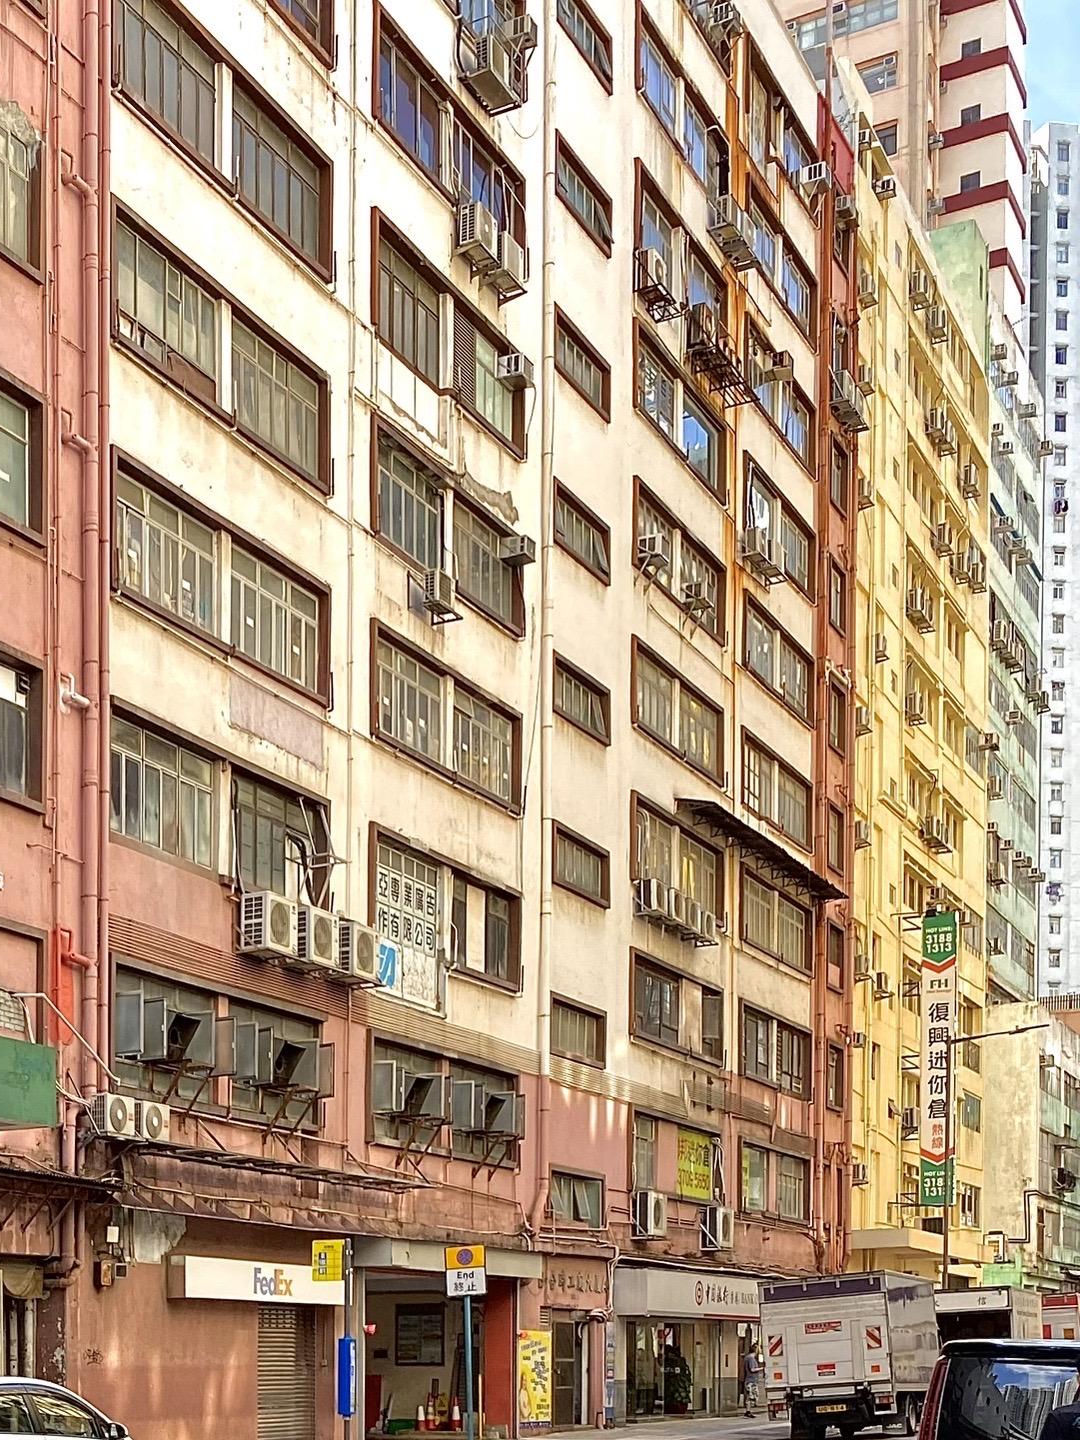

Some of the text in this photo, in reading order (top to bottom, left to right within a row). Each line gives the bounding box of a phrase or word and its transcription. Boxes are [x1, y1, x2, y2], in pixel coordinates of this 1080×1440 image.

[925, 932, 952, 944] 3188
[926, 942, 952, 953] 1313
[928, 1002, 949, 1119] 復興迷你倉
[456, 1270, 475, 1280] End
[253, 1266, 293, 1297] FedEx
[453, 1281, 477, 1293] 終止
